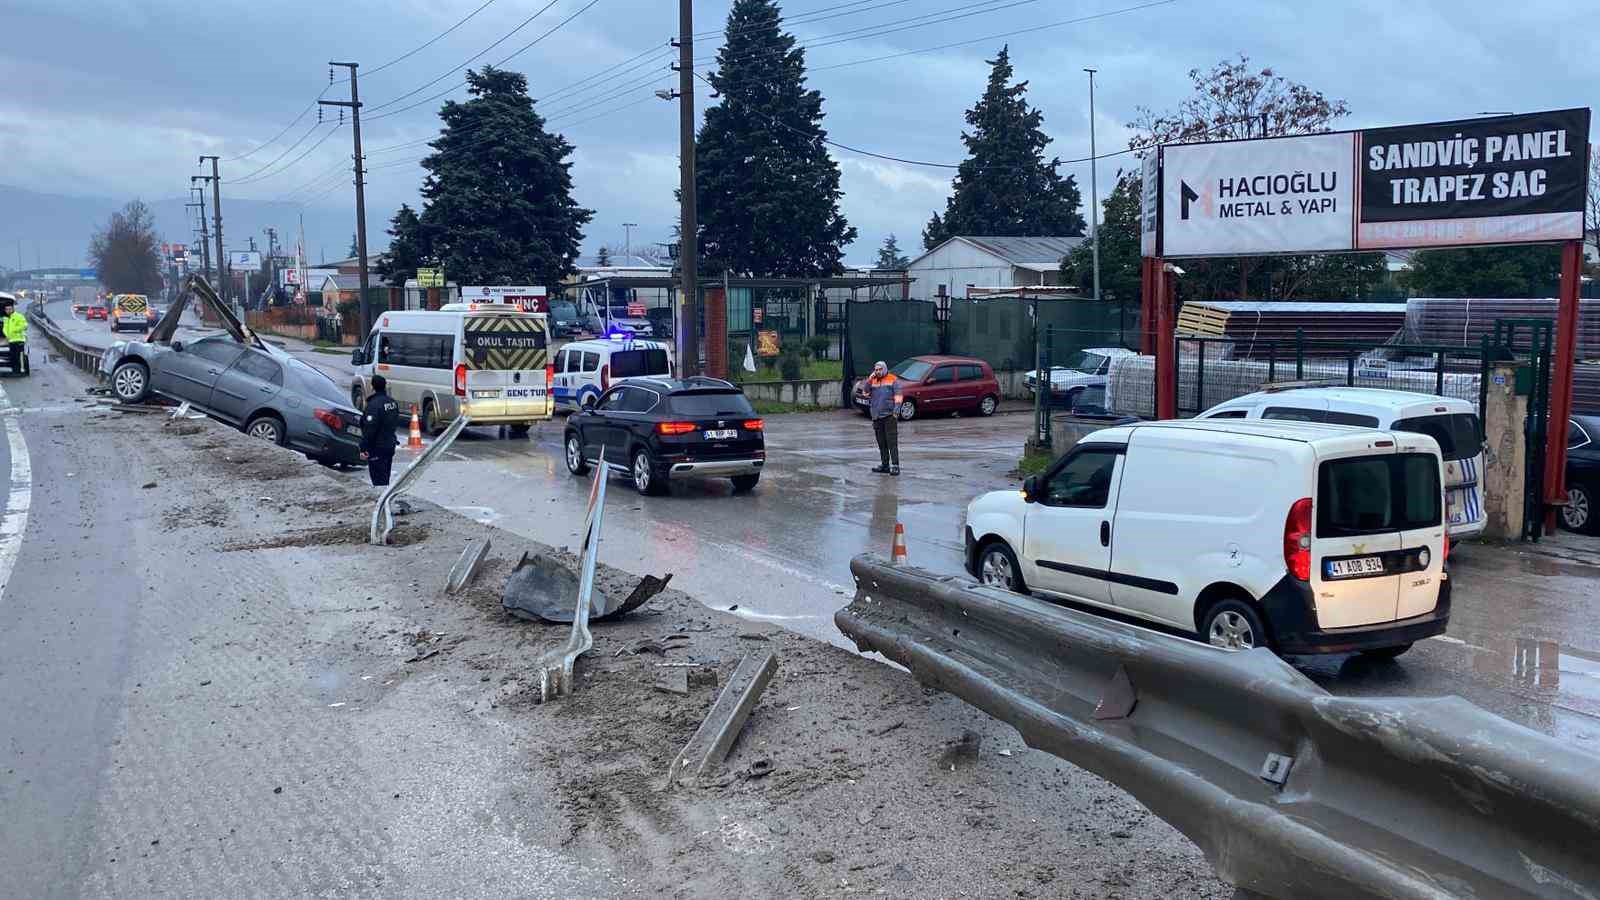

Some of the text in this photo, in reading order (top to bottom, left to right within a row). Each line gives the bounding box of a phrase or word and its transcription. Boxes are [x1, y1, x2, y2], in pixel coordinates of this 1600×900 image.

[1368, 129, 1571, 170] SANDVİÇ PANEL
[1219, 170, 1337, 198] HACIOĞLU
[1390, 168, 1547, 205] TRAPEZ SAC
[1219, 197, 1337, 218] METAL & YAPI
[477, 337, 503, 347] OKUL
[1333, 561, 1343, 574] 41
[1366, 557, 1382, 571] 934
